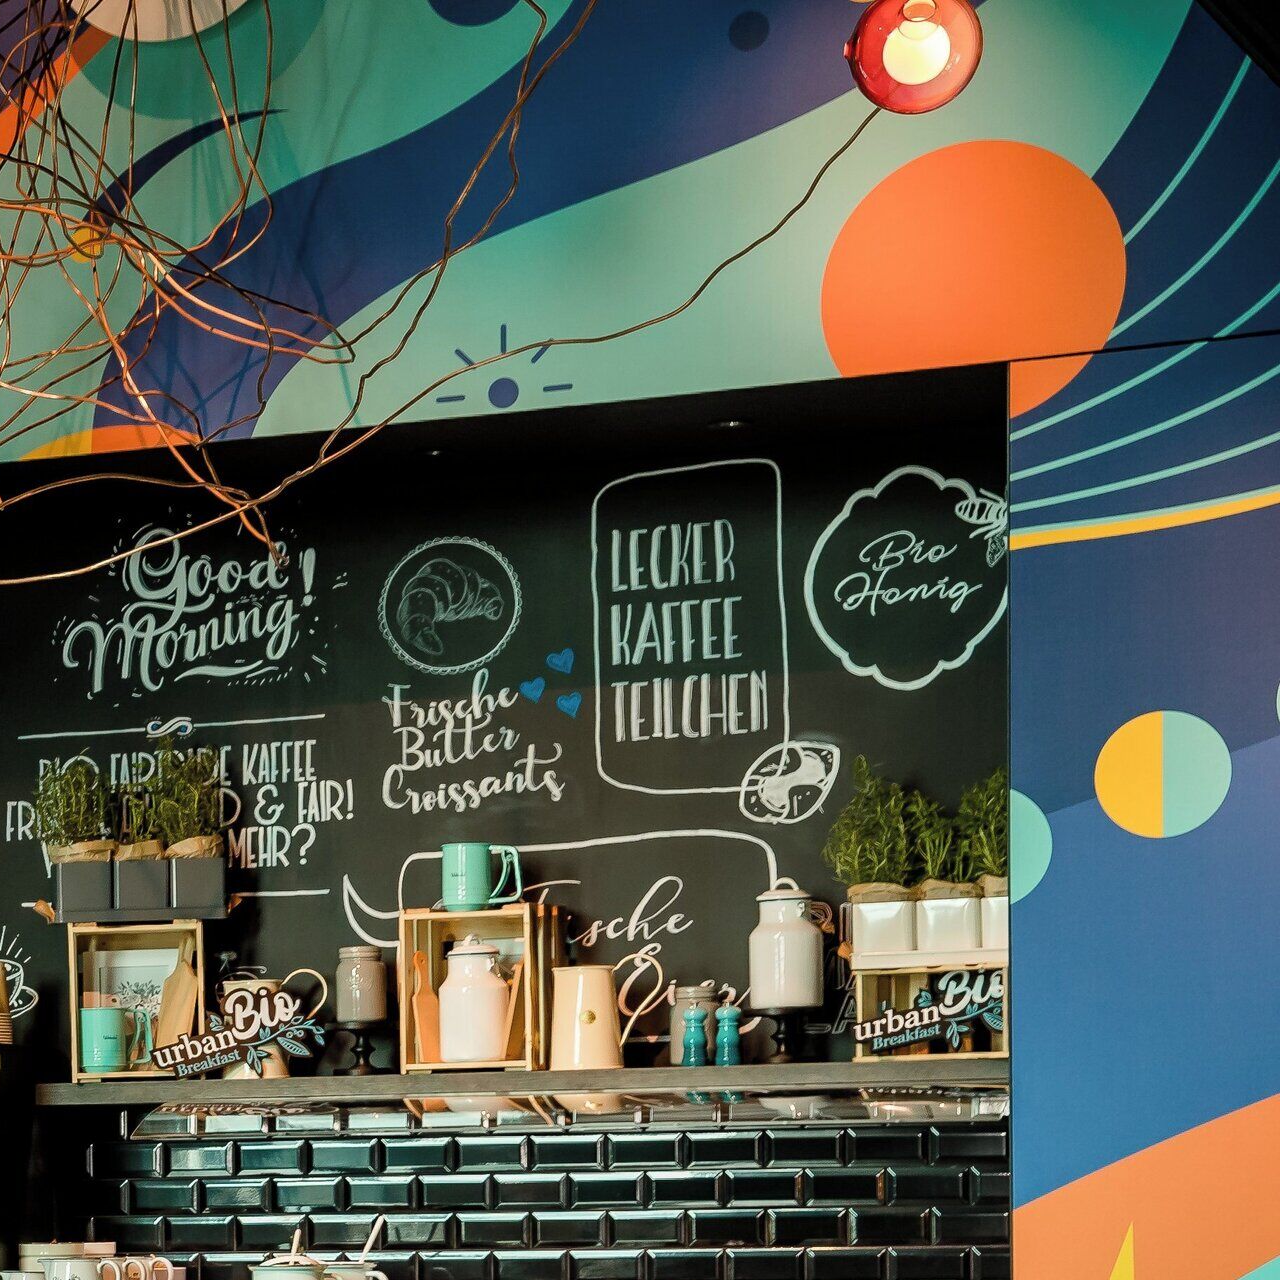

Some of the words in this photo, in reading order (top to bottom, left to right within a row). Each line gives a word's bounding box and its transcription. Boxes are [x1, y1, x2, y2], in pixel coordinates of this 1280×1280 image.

[611, 519, 735, 592] LECKER
[858, 530, 958, 572] Bio
[834, 567, 983, 617] Honig
[62, 598, 301, 694] Morning
[611, 596, 743, 666] KAFFEE
[381, 667, 519, 728] Frische
[610, 670, 769, 743] TEILCHEN
[242, 739, 317, 787] KAFFEE
[393, 712, 521, 771] Butter
[254, 784, 285, 826] &
[297, 778, 355, 825] FAIR!
[382, 742, 566, 815] Croissants
[228, 823, 317, 869] MEHR?
[152, 1030, 238, 1068] urban
[225, 989, 301, 1041] Bio
[852, 1004, 941, 1041] urban
[872, 1023, 942, 1050] Breakfast
[175, 1048, 241, 1078] Breakfast
